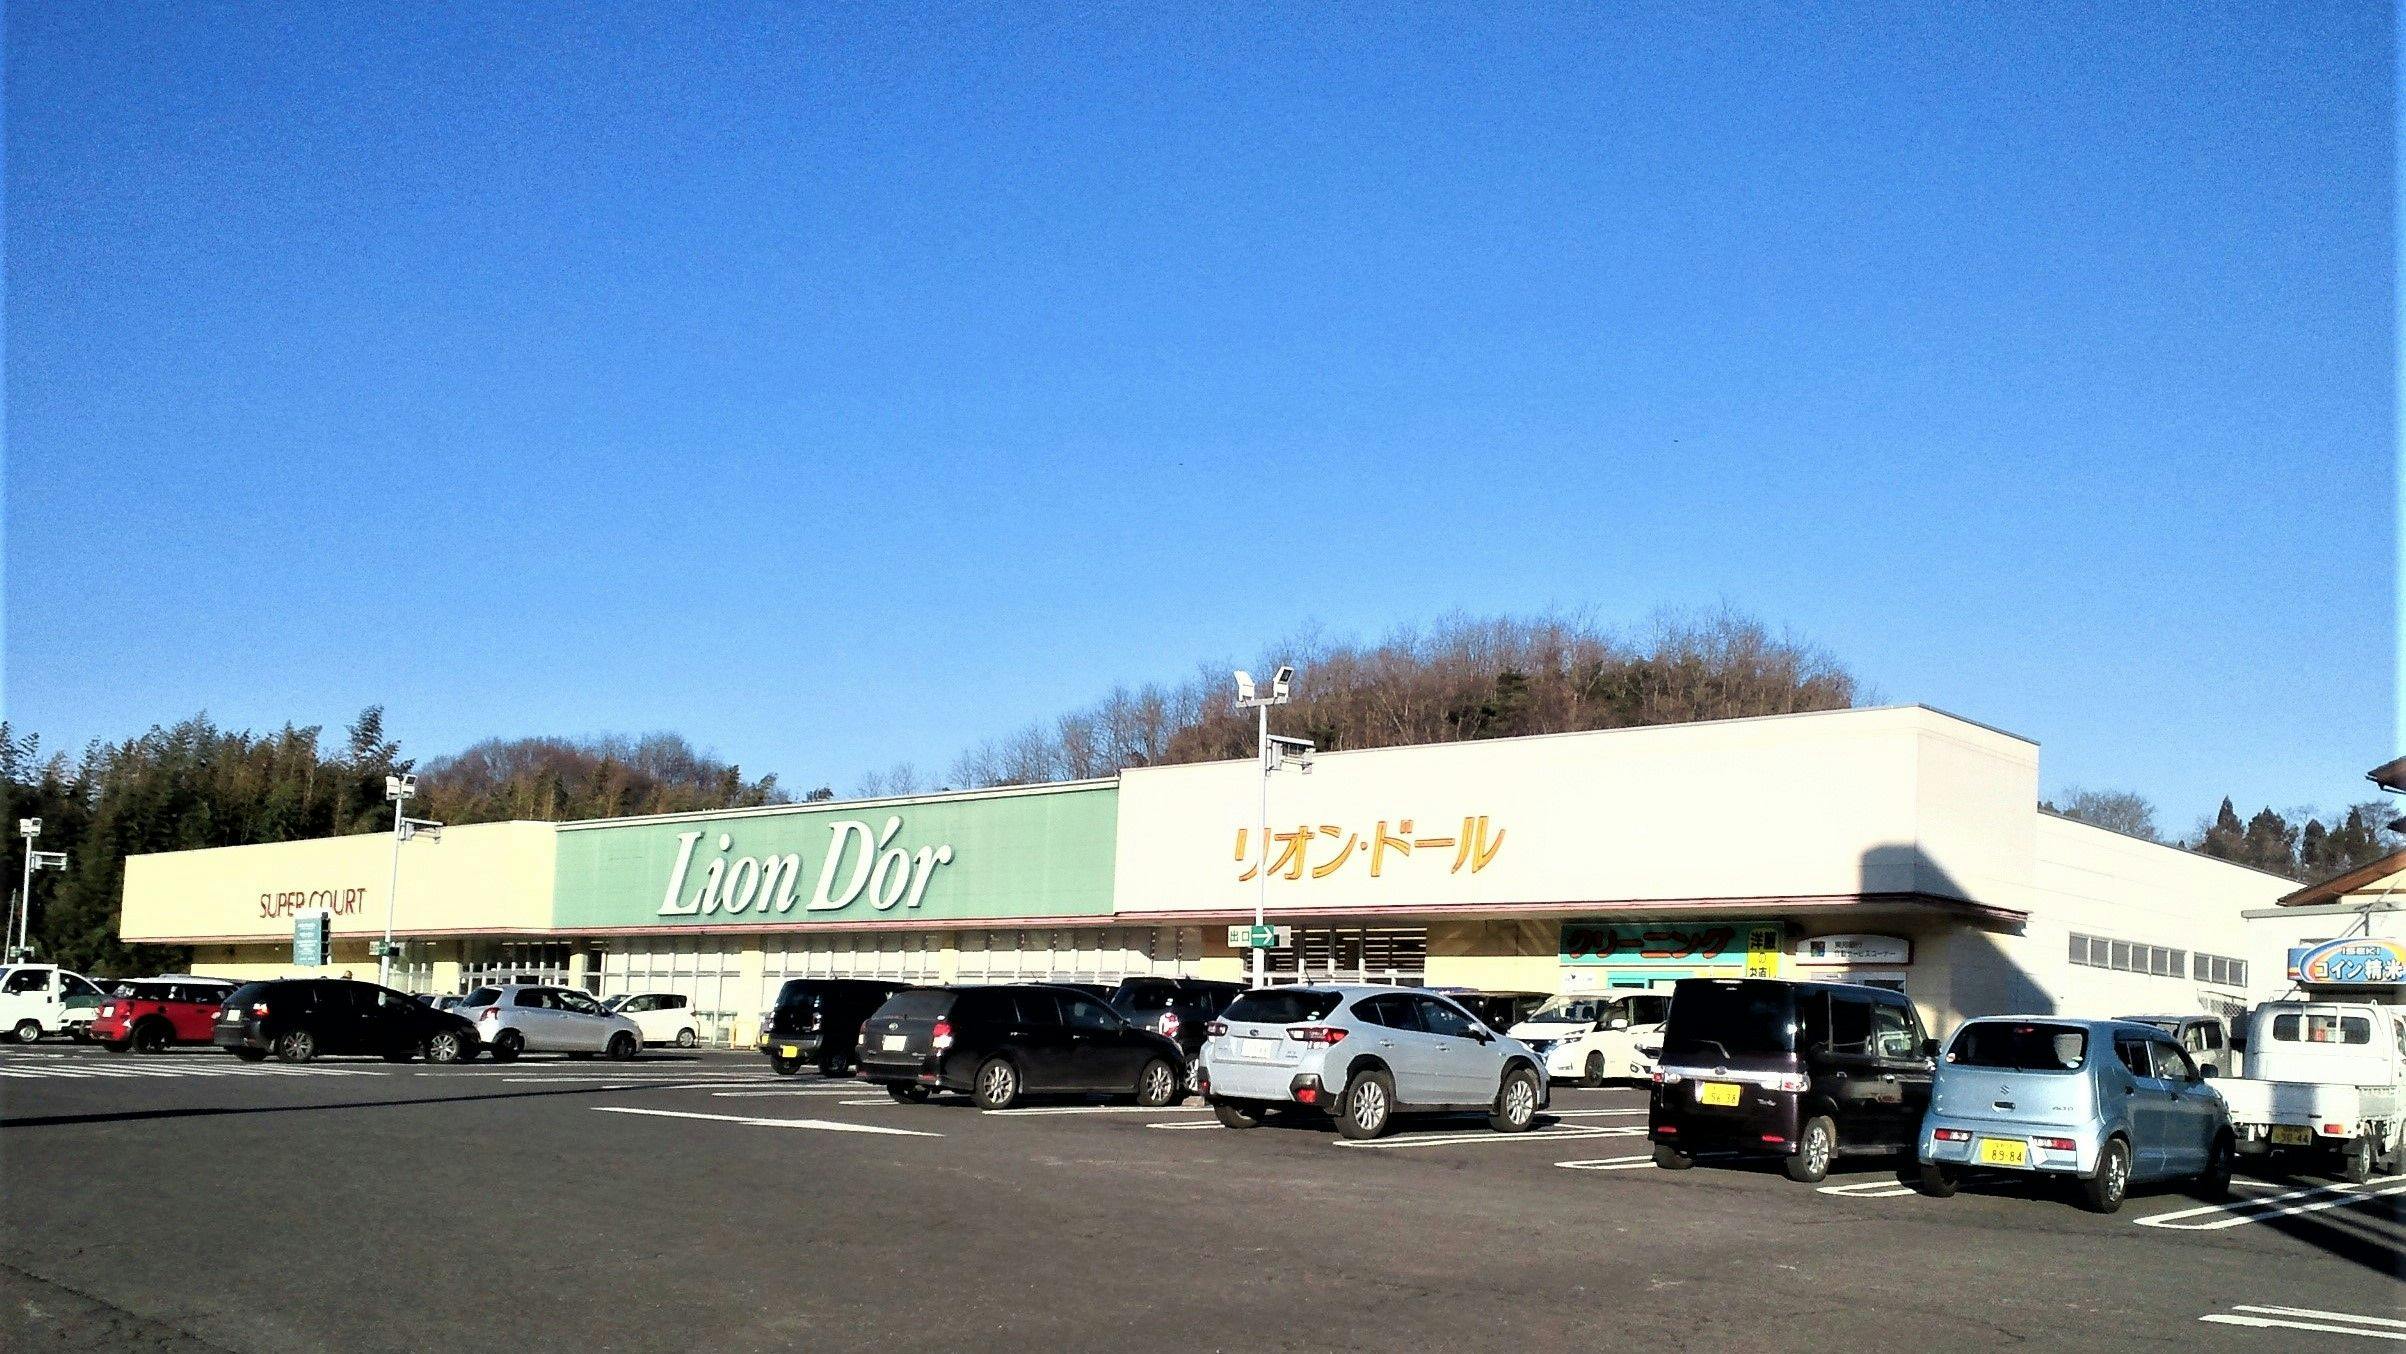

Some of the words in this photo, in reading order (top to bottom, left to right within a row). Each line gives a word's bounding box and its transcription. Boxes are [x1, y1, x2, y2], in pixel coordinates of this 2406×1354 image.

[657, 831, 802, 915] Lion
[806, 815, 954, 912] D'or
[1235, 815, 1507, 882] リオン・ドール
[260, 892, 306, 918] SUPER
[309, 887, 367, 915] COURT
[1230, 930, 1249, 942] 出口
[1567, 926, 1736, 959] クリーニング
